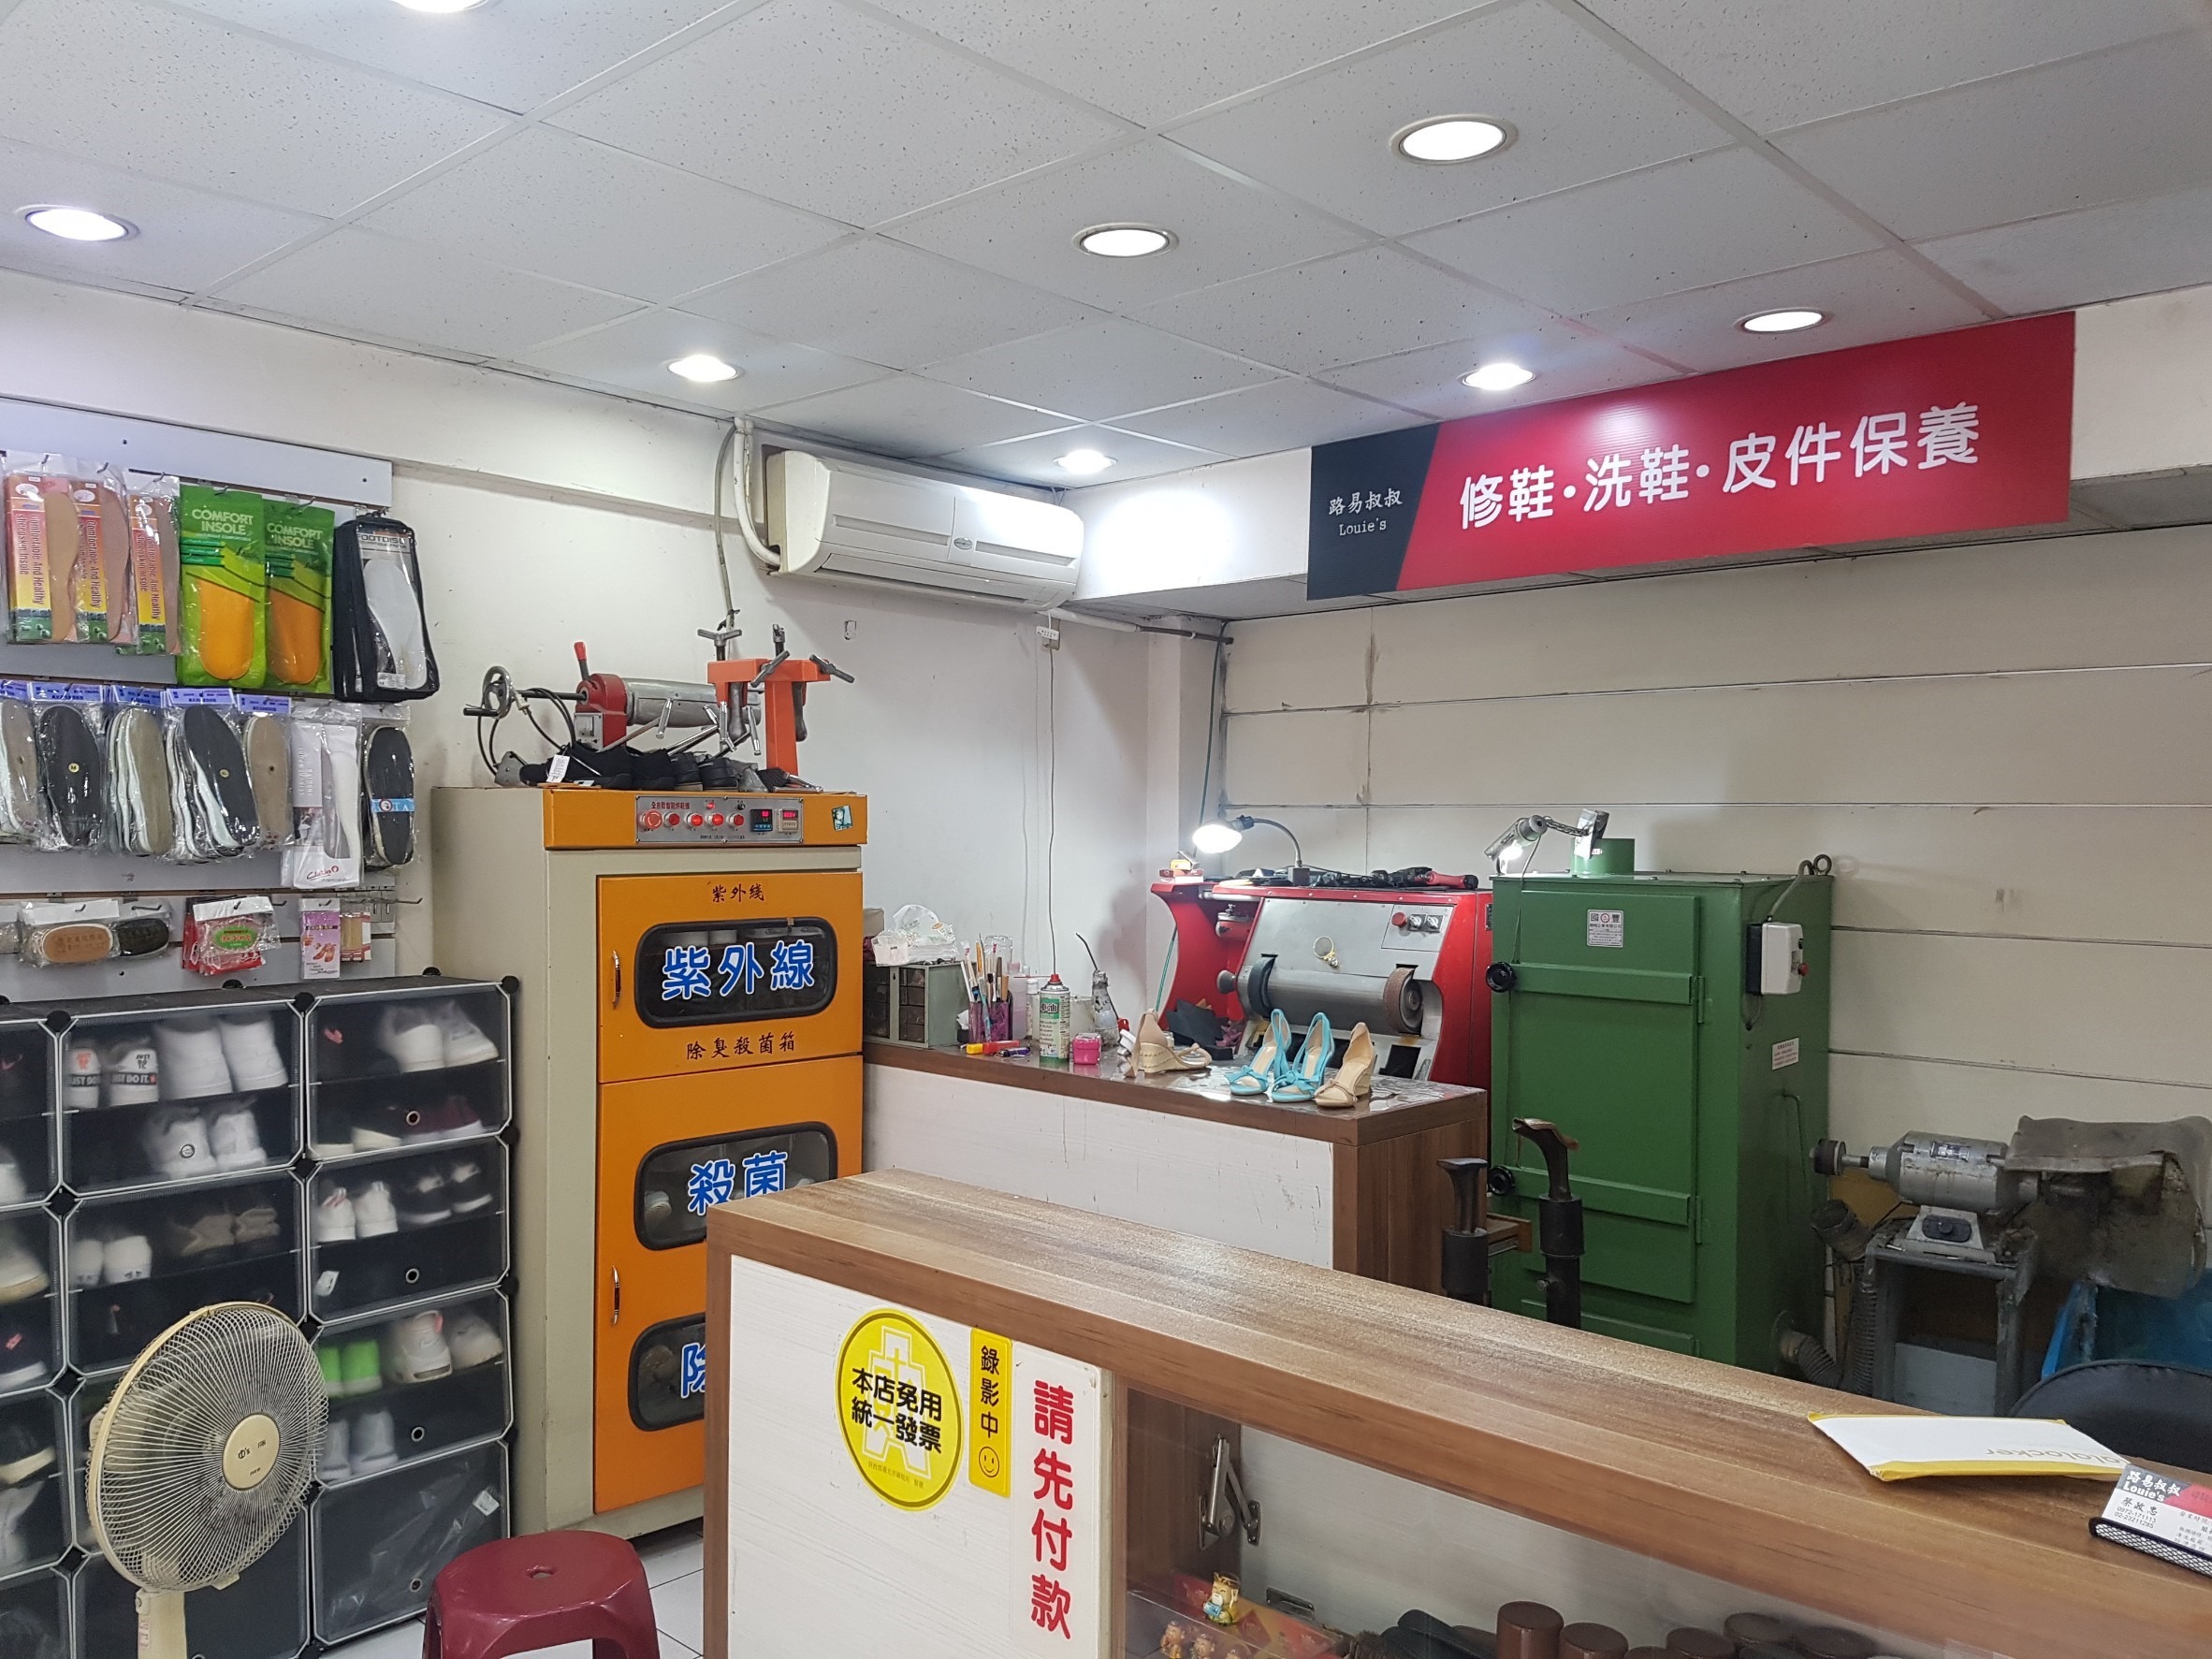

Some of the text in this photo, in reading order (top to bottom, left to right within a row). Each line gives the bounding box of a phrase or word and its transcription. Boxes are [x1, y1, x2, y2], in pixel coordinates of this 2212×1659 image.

[1329, 488, 1403, 516] 路易叔叔
[192, 508, 254, 525] COMFORT
[201, 520, 247, 535] INSOLE
[1339, 517, 1387, 536] Louie's
[267, 523, 323, 540] COMFORT
[274, 534, 315, 549] INSOLE
[33, 577, 45, 604] Healthy
[91, 581, 102, 608] Healthy
[151, 593, 162, 620] Healthy
[662, 939, 815, 1000] 紫外線
[686, 1030, 794, 1060] 除臭殺菌箱
[688, 1150, 787, 1215] 殺菌
[851, 1367, 942, 1422] 本店免用
[979, 1345, 1000, 1439] 錄影中
[851, 1396, 942, 1454] 統一發票
[1986, 1448, 2131, 1464] alalocker
[2123, 1480, 2165, 1502] Louie's
[2126, 1470, 2181, 1497] 路易叔叔
[1031, 1379, 1075, 1640] 請先付款
